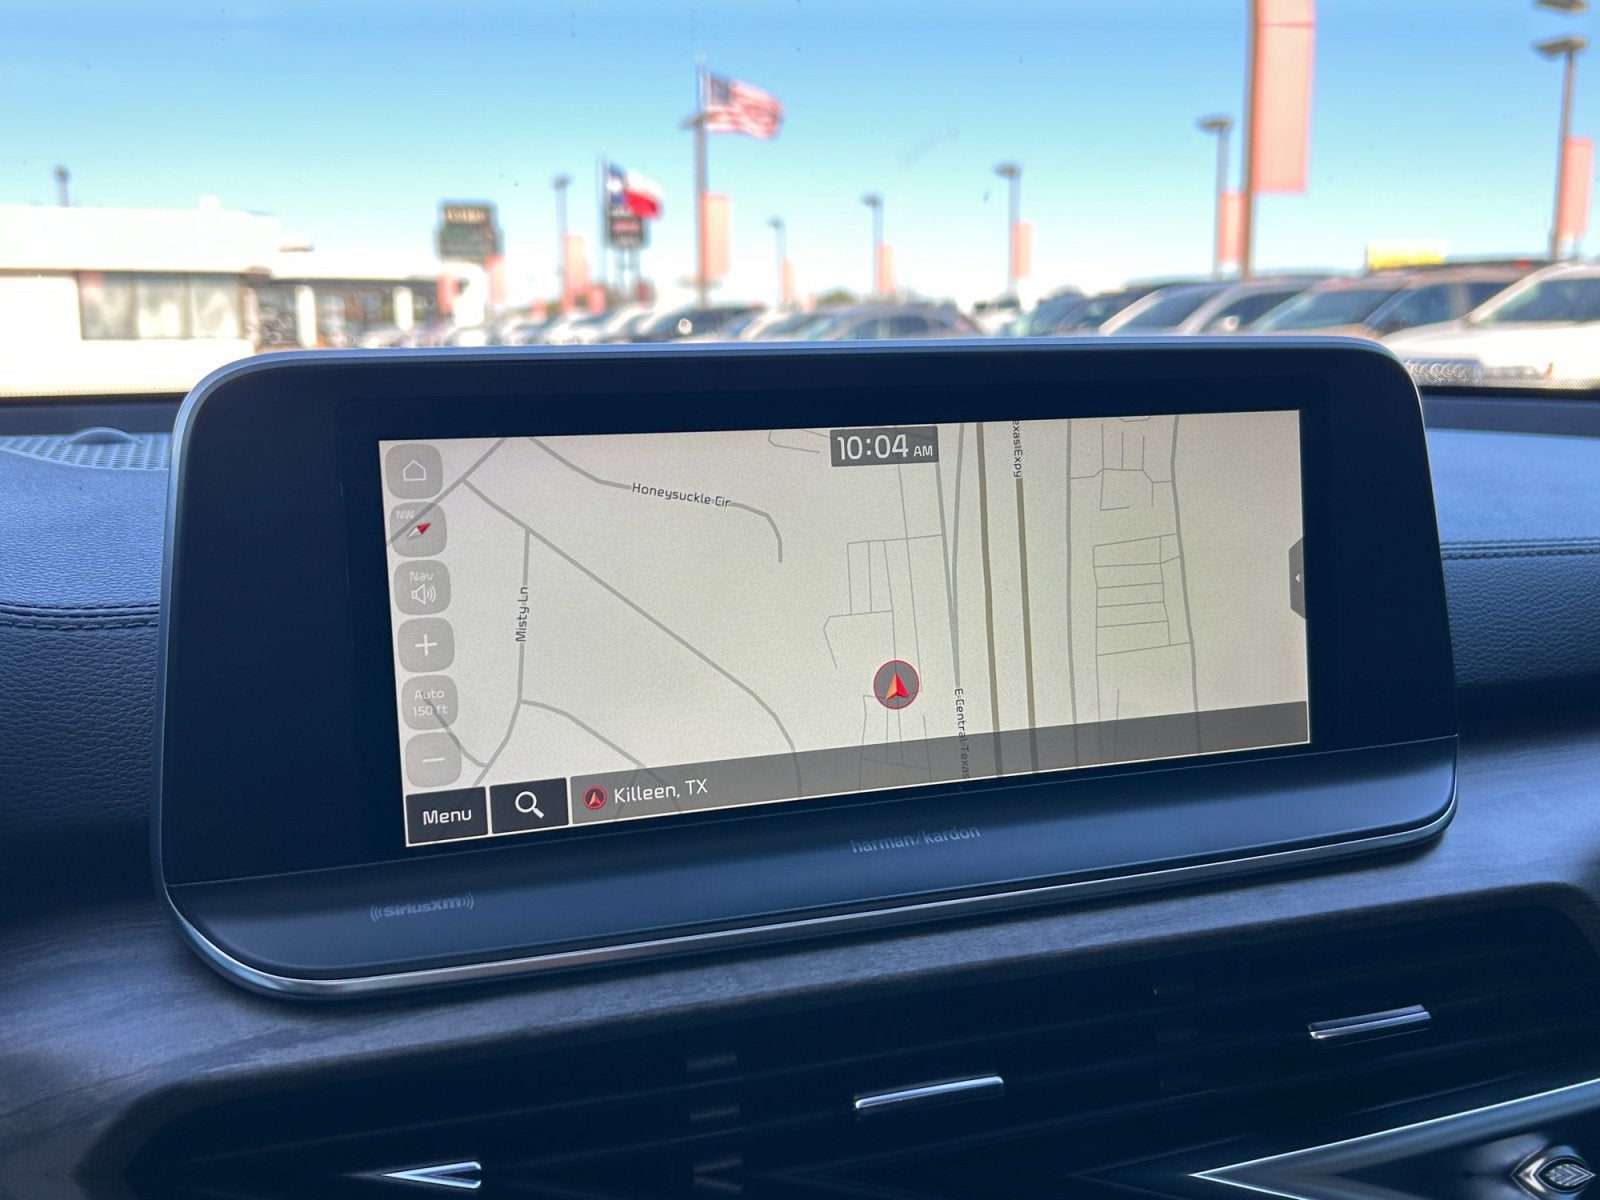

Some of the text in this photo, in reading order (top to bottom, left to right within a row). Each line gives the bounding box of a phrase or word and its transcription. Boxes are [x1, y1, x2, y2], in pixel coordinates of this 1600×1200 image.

[837, 433, 934, 461] 10:04 AM
[1013, 449, 1023, 478] Expy
[631, 482, 731, 508] Honeysuckle Cir
[395, 510, 415, 520] NW
[409, 571, 434, 582] Nav
[515, 586, 530, 642] Misty Ln
[414, 688, 445, 701] Auto
[954, 687, 964, 696] E
[412, 704, 449, 717] 150 ft
[955, 698, 968, 743] Central
[614, 778, 708, 804] Killeen, TX
[422, 808, 473, 825] Menu
